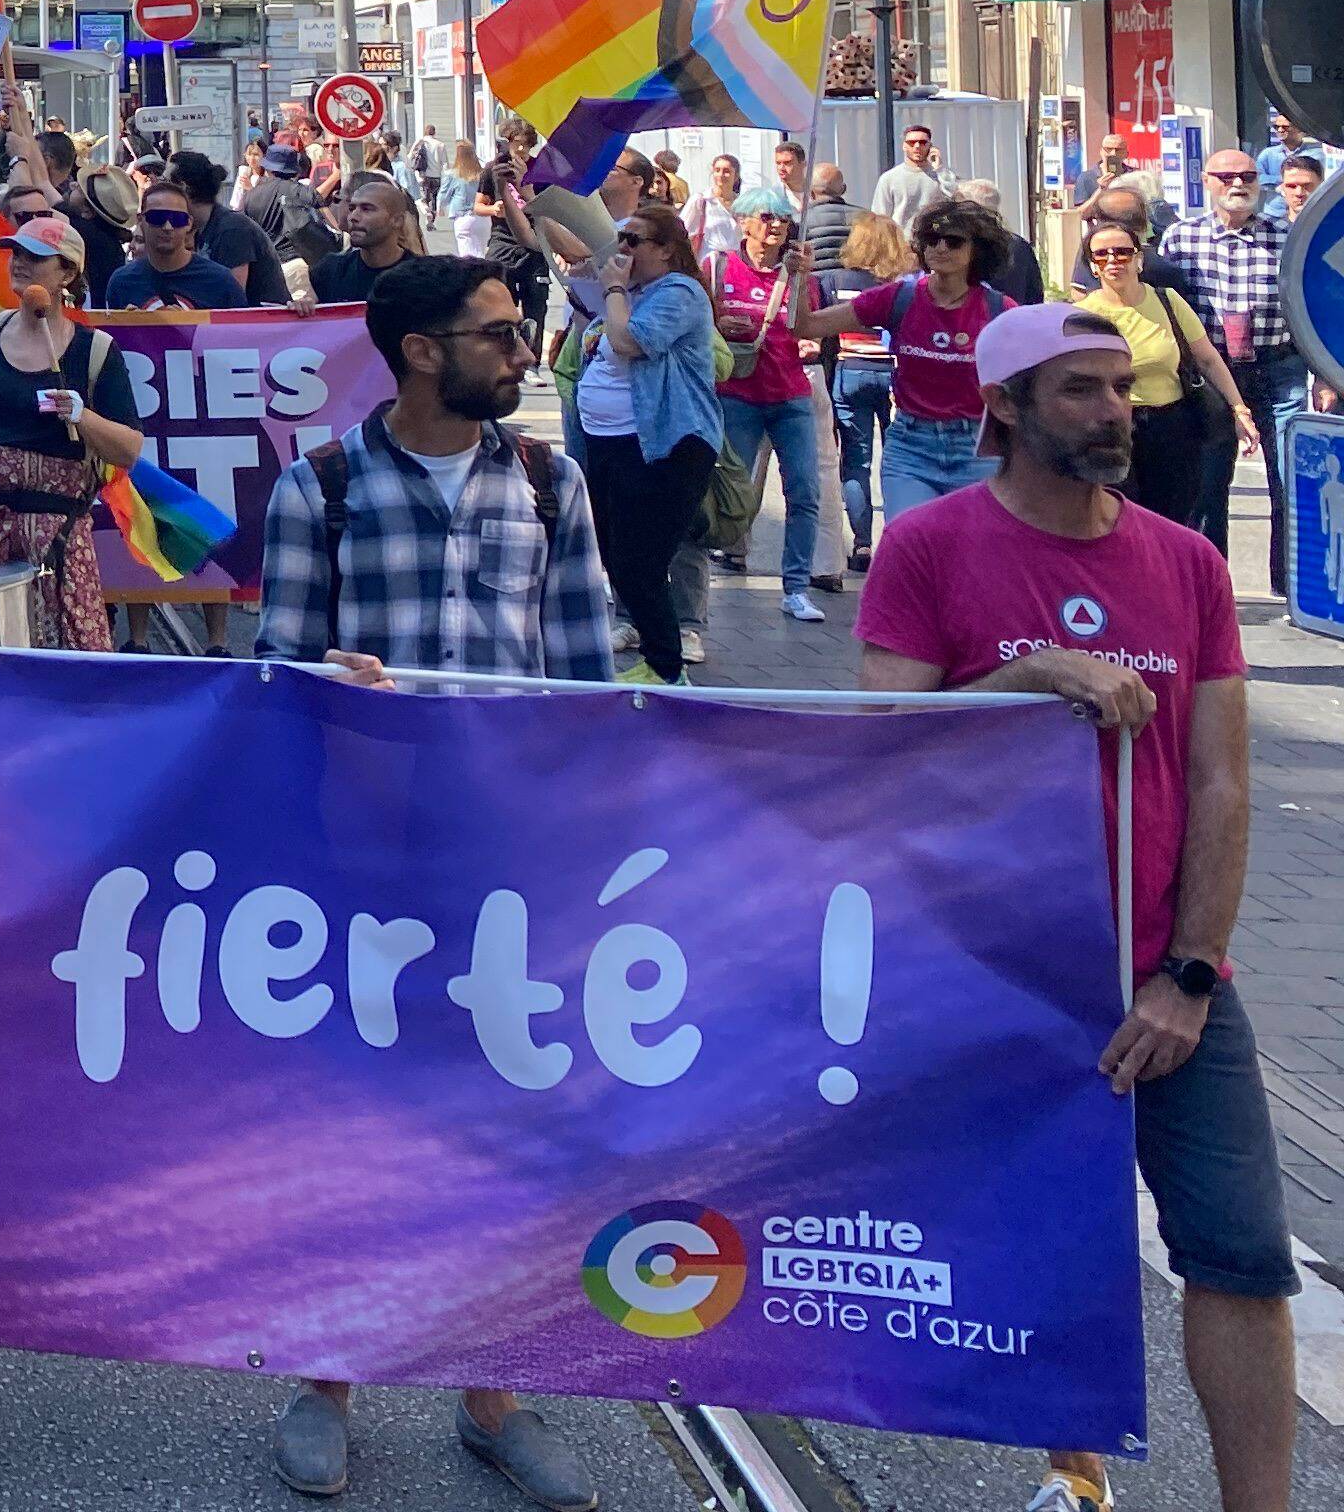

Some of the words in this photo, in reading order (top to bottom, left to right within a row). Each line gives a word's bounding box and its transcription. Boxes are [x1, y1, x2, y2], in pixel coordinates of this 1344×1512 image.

[359, 48, 402, 61] ANGE
[127, 347, 329, 419] BIES
[51, 847, 703, 1091] fierté
[762, 1209, 924, 1252] centre
[772, 1254, 943, 1294] LGBTQIA+
[762, 1292, 870, 1333] côte
